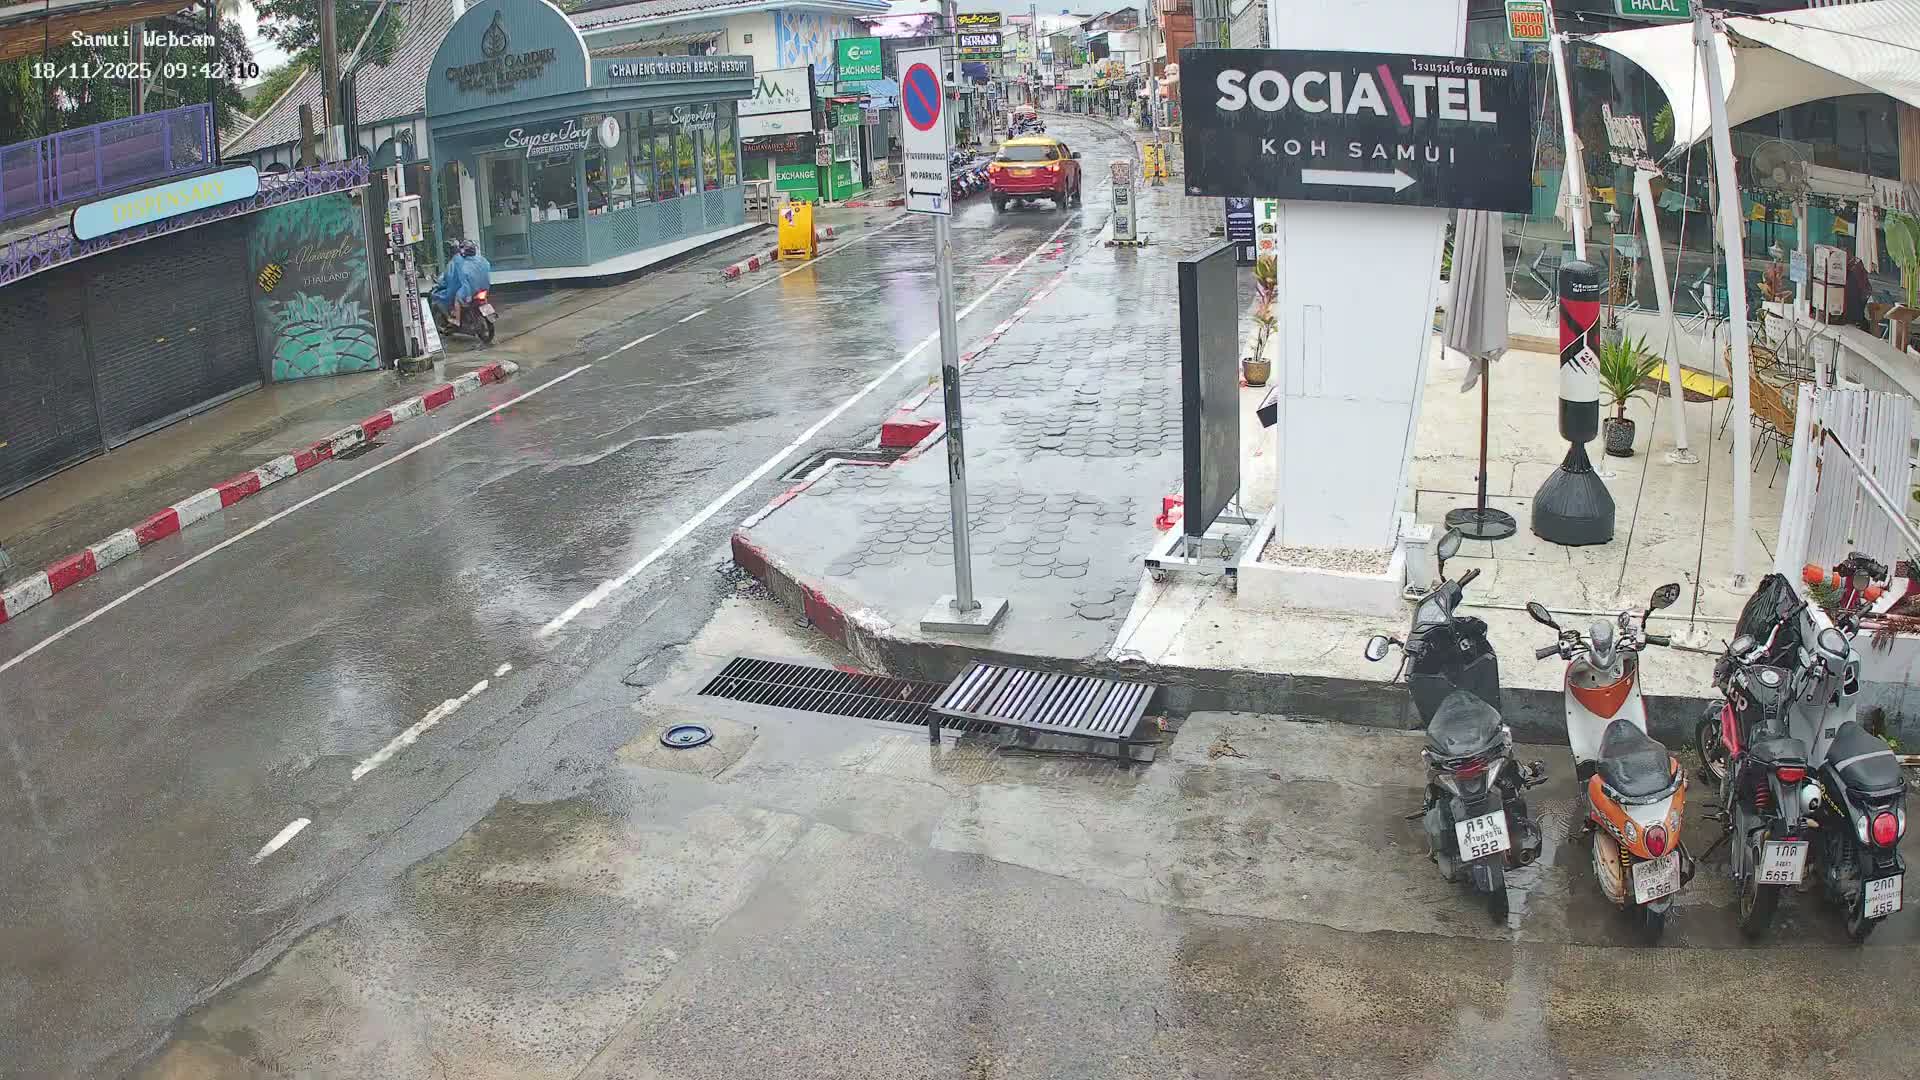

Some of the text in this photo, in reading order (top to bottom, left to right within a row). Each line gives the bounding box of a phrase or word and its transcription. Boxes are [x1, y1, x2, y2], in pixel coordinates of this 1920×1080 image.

[1511, 11, 1544, 24] INDIAN
[1513, 24, 1544, 38] FOOD
[612, 60, 748, 77] CHAWENG GARDEN BEACH RESORT
[840, 65, 881, 75] EXCHANGE
[1261, 139, 1455, 164] KOH SAMUI
[776, 170, 815, 181] EXCHANGE
[910, 171, 943, 181] NO PARKING
[113, 179, 225, 225] DISPENSARY
[303, 271, 350, 287] THAILAND
[1471, 840, 1499, 857] 522
[1765, 870, 1795, 881] 5651
[1872, 901, 1893, 915] 455
